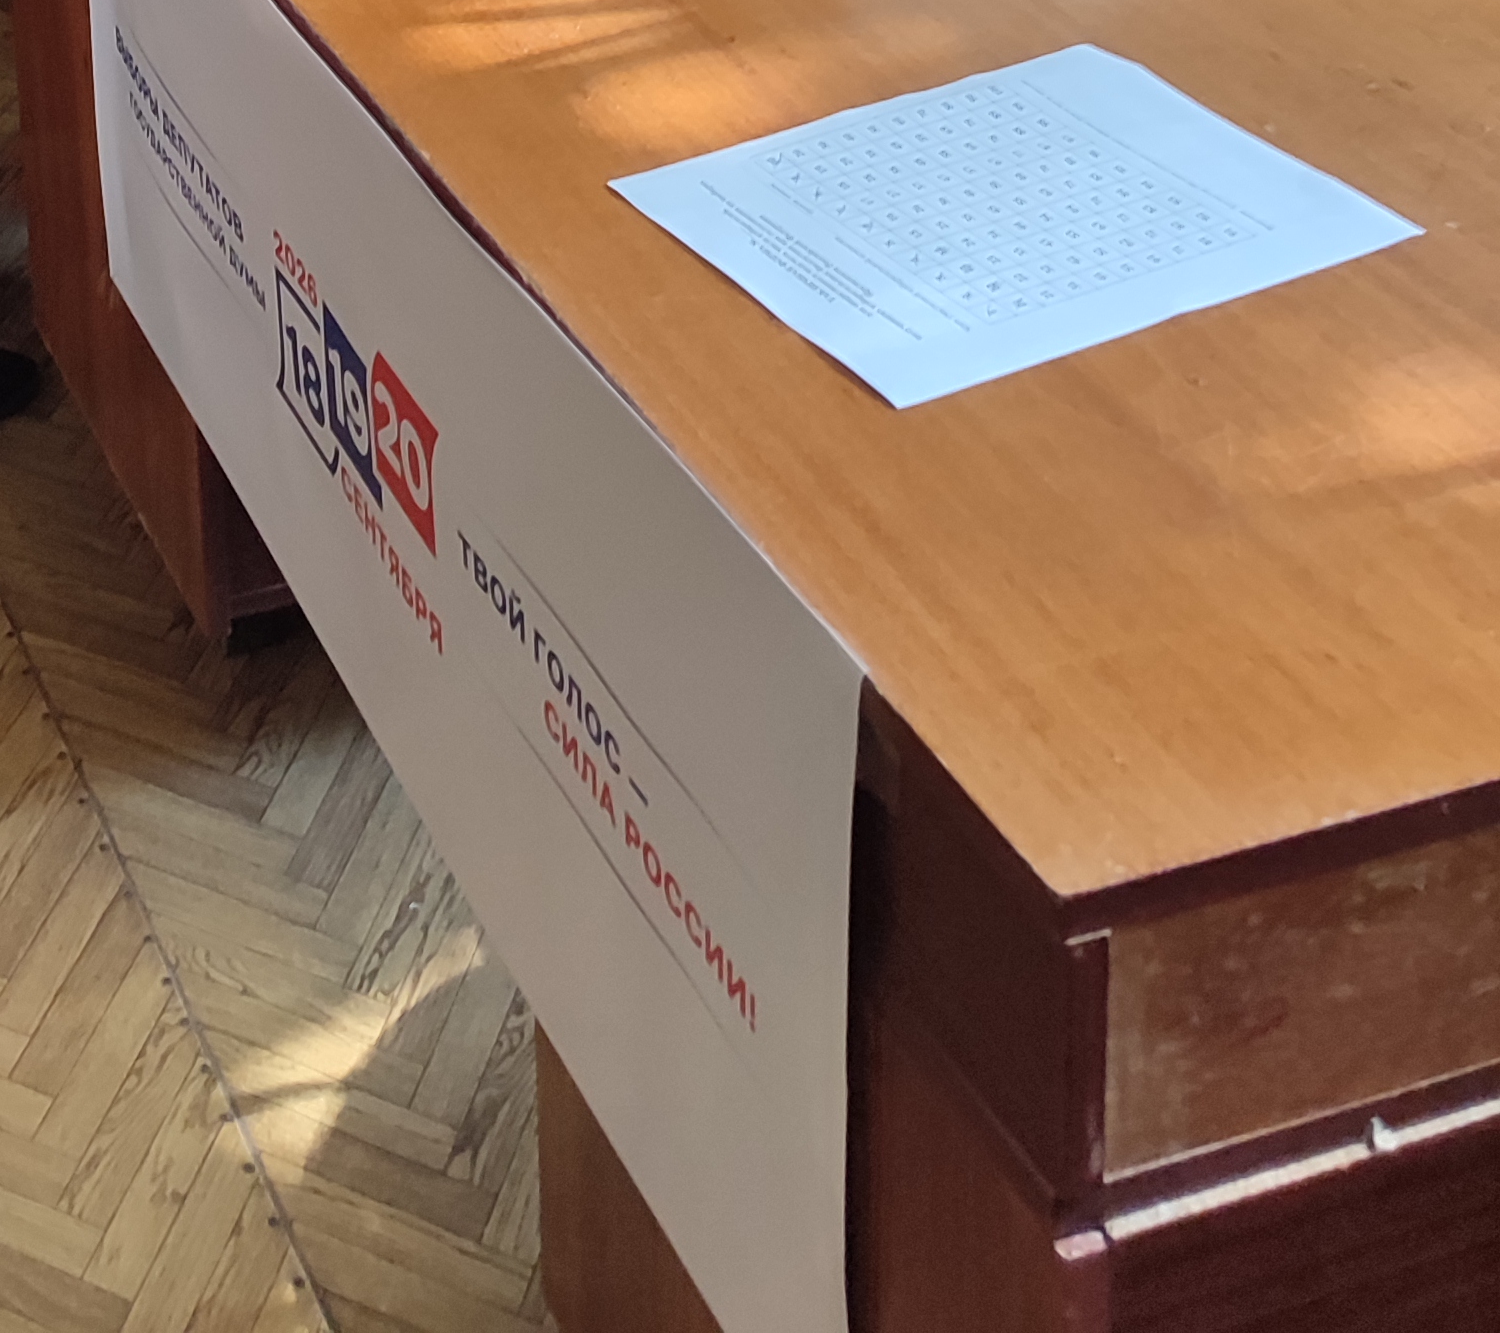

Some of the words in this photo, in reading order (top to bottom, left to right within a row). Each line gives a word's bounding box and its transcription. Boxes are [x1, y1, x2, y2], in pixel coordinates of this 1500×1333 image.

[162, 108, 245, 244] ДЕПУТАТОВ
[273, 229, 319, 308] 2026
[229, 244, 267, 312] ДУМЫ
[285, 325, 325, 428] 18
[327, 346, 370, 457] 19
[373, 380, 429, 512] 20
[341, 465, 444, 656] СЕНТЯБРЯ
[457, 529, 526, 645] ТВОЙ
[533, 627, 621, 775] ГОЛОС
[544, 699, 617, 828] СИЛА
[624, 810, 757, 1034] РОССИИ!
